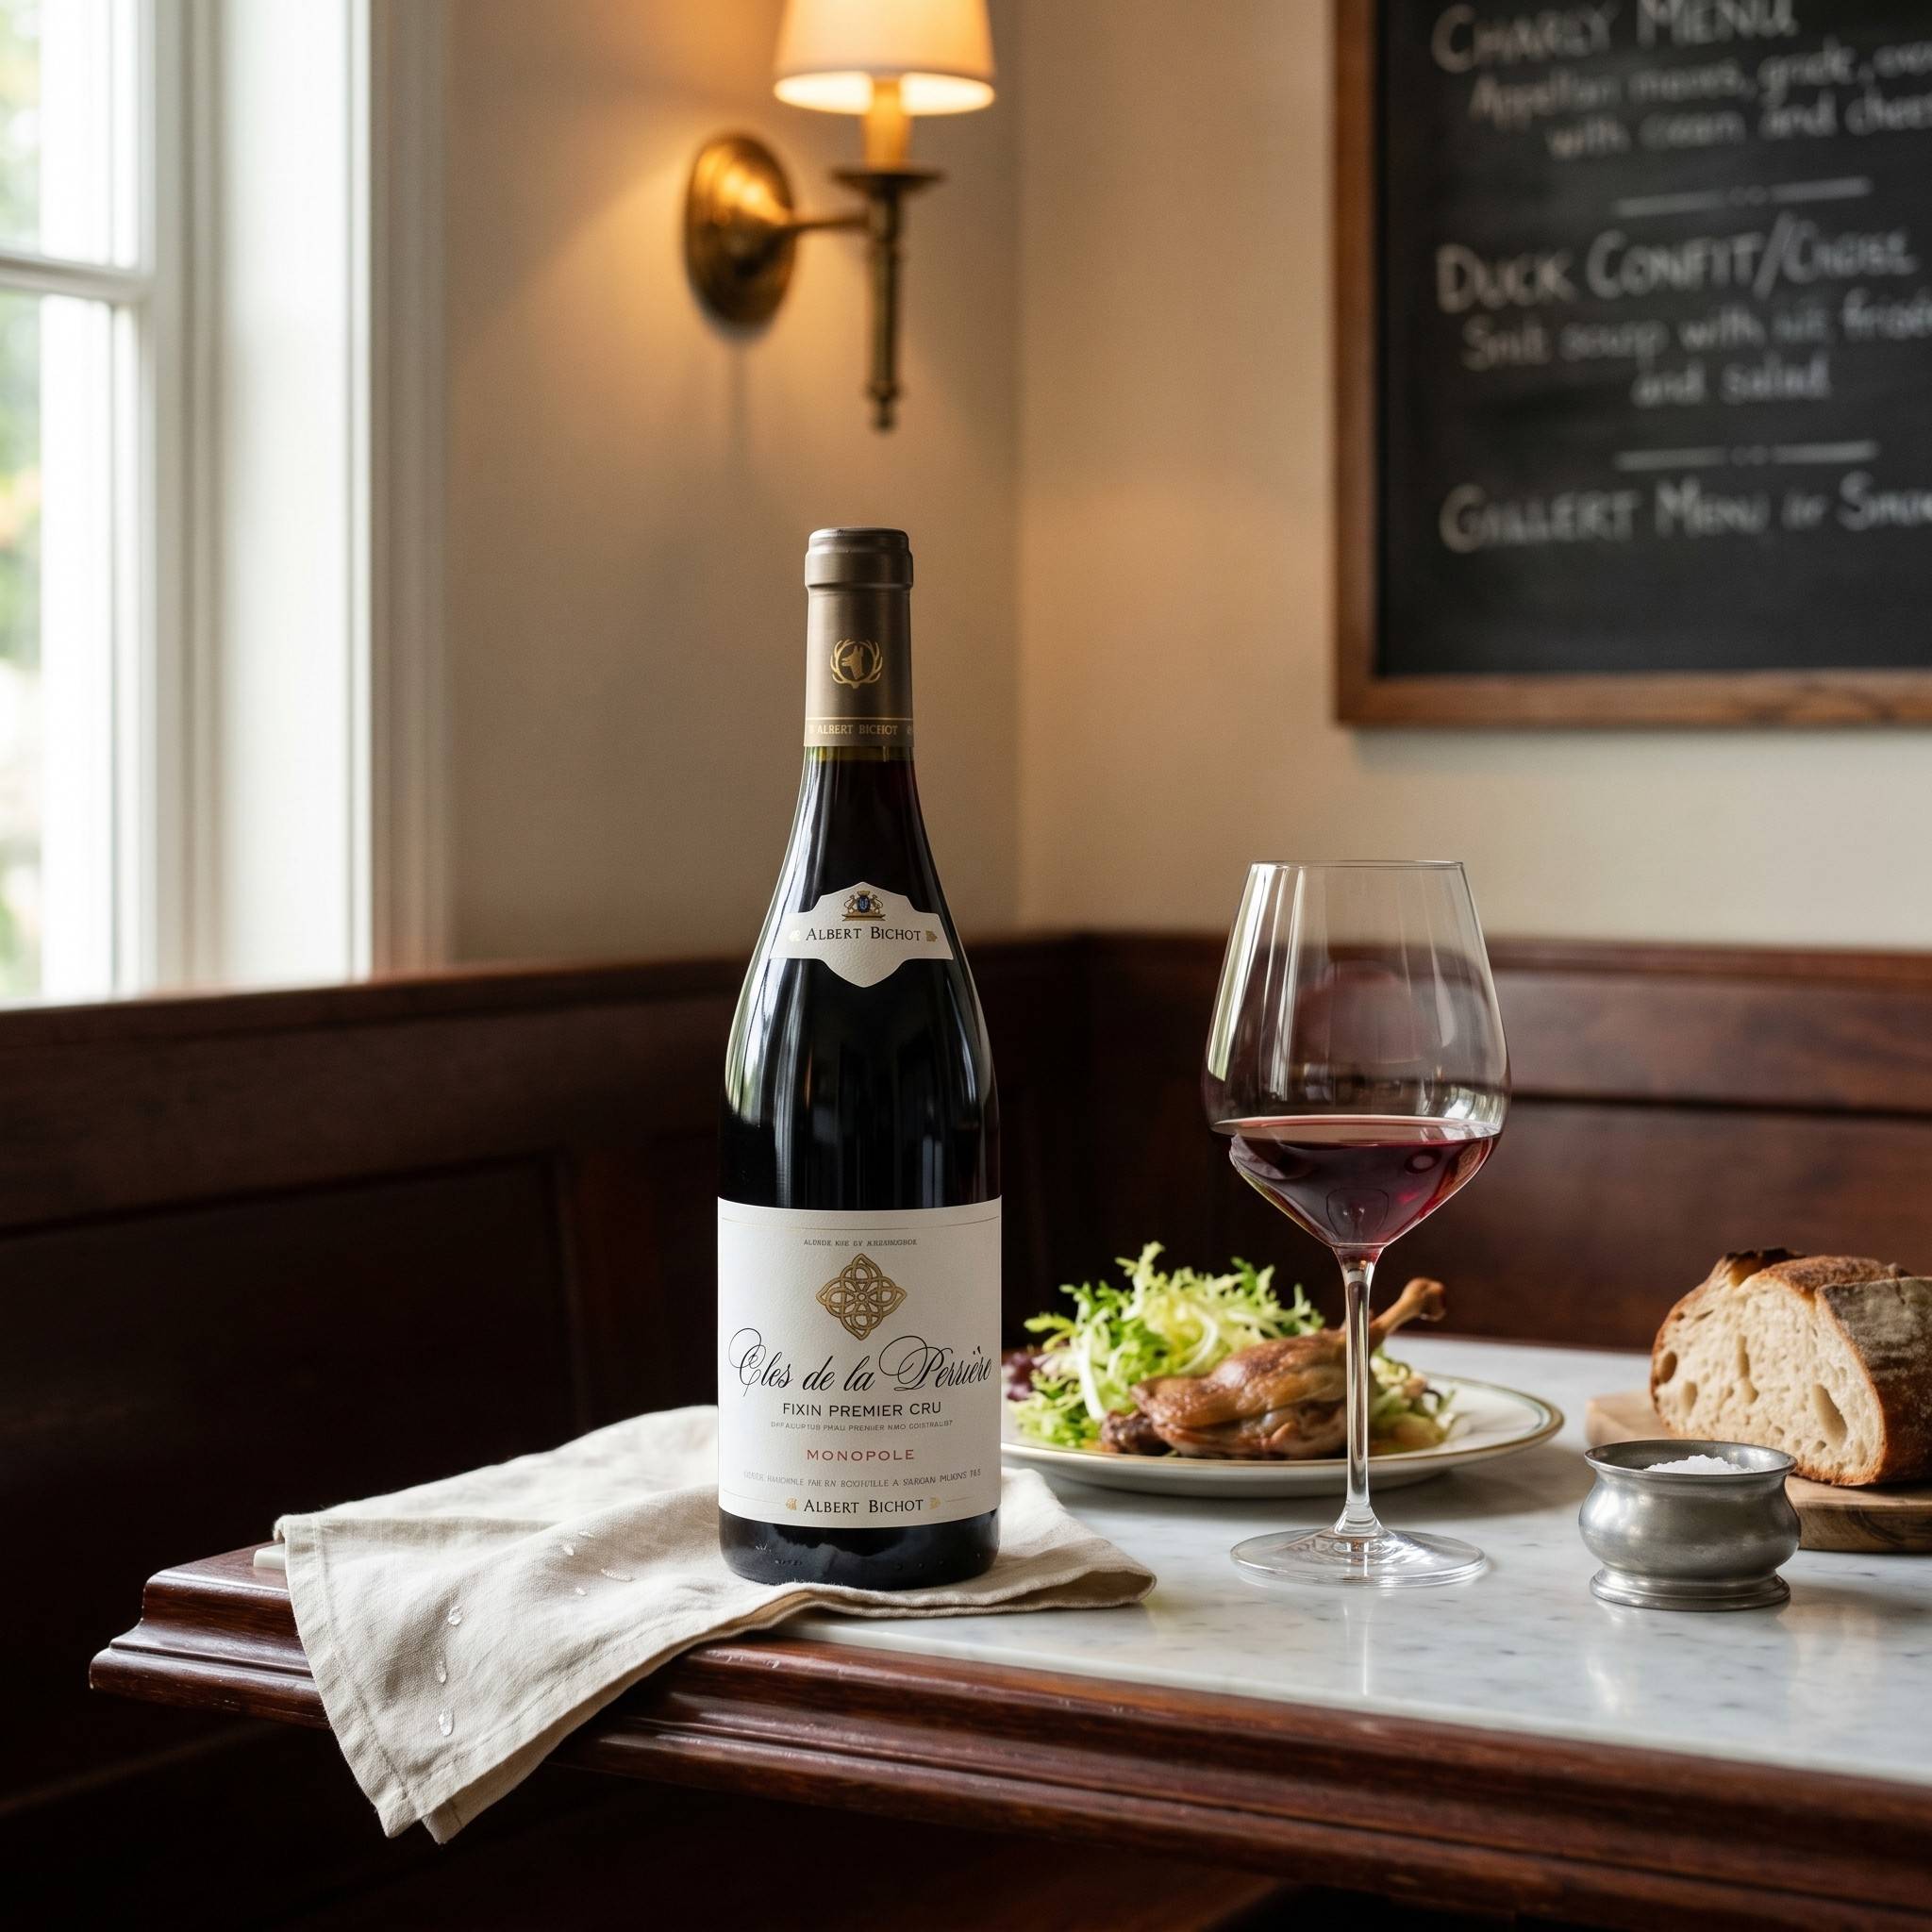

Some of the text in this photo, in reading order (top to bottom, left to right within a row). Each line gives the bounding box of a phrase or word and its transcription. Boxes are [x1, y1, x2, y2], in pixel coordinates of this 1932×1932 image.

[806, 926, 921, 941] ALBERT BICHOT
[802, 1356, 836, 1391] de
[843, 1356, 876, 1391] la
[783, 1402, 941, 1417] FIXIN PREMIER CRU
[807, 1449, 915, 1461] MONOPOLE
[804, 1498, 924, 1514] ALBERT BICHOT
